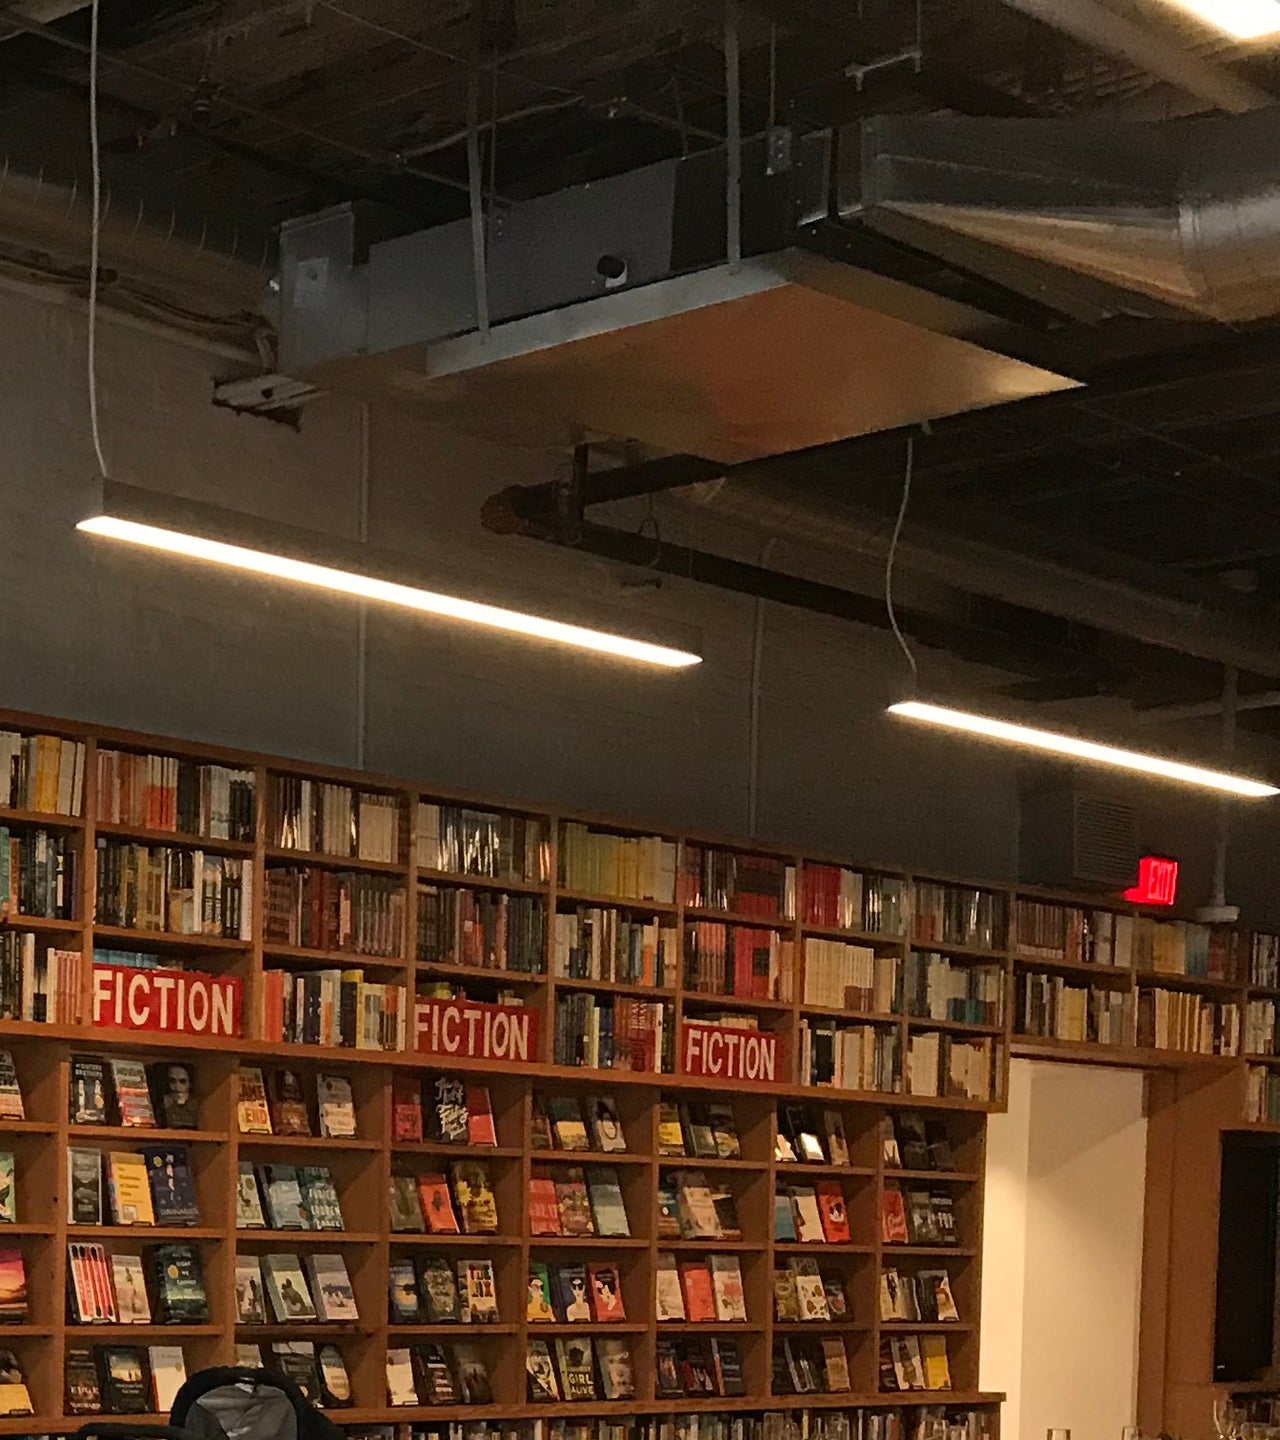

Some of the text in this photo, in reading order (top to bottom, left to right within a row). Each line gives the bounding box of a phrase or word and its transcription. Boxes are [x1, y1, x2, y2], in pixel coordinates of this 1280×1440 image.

[93, 968, 235, 1036] FICTION
[414, 1003, 529, 1061] FICTION
[686, 1022, 777, 1083] FICTION
